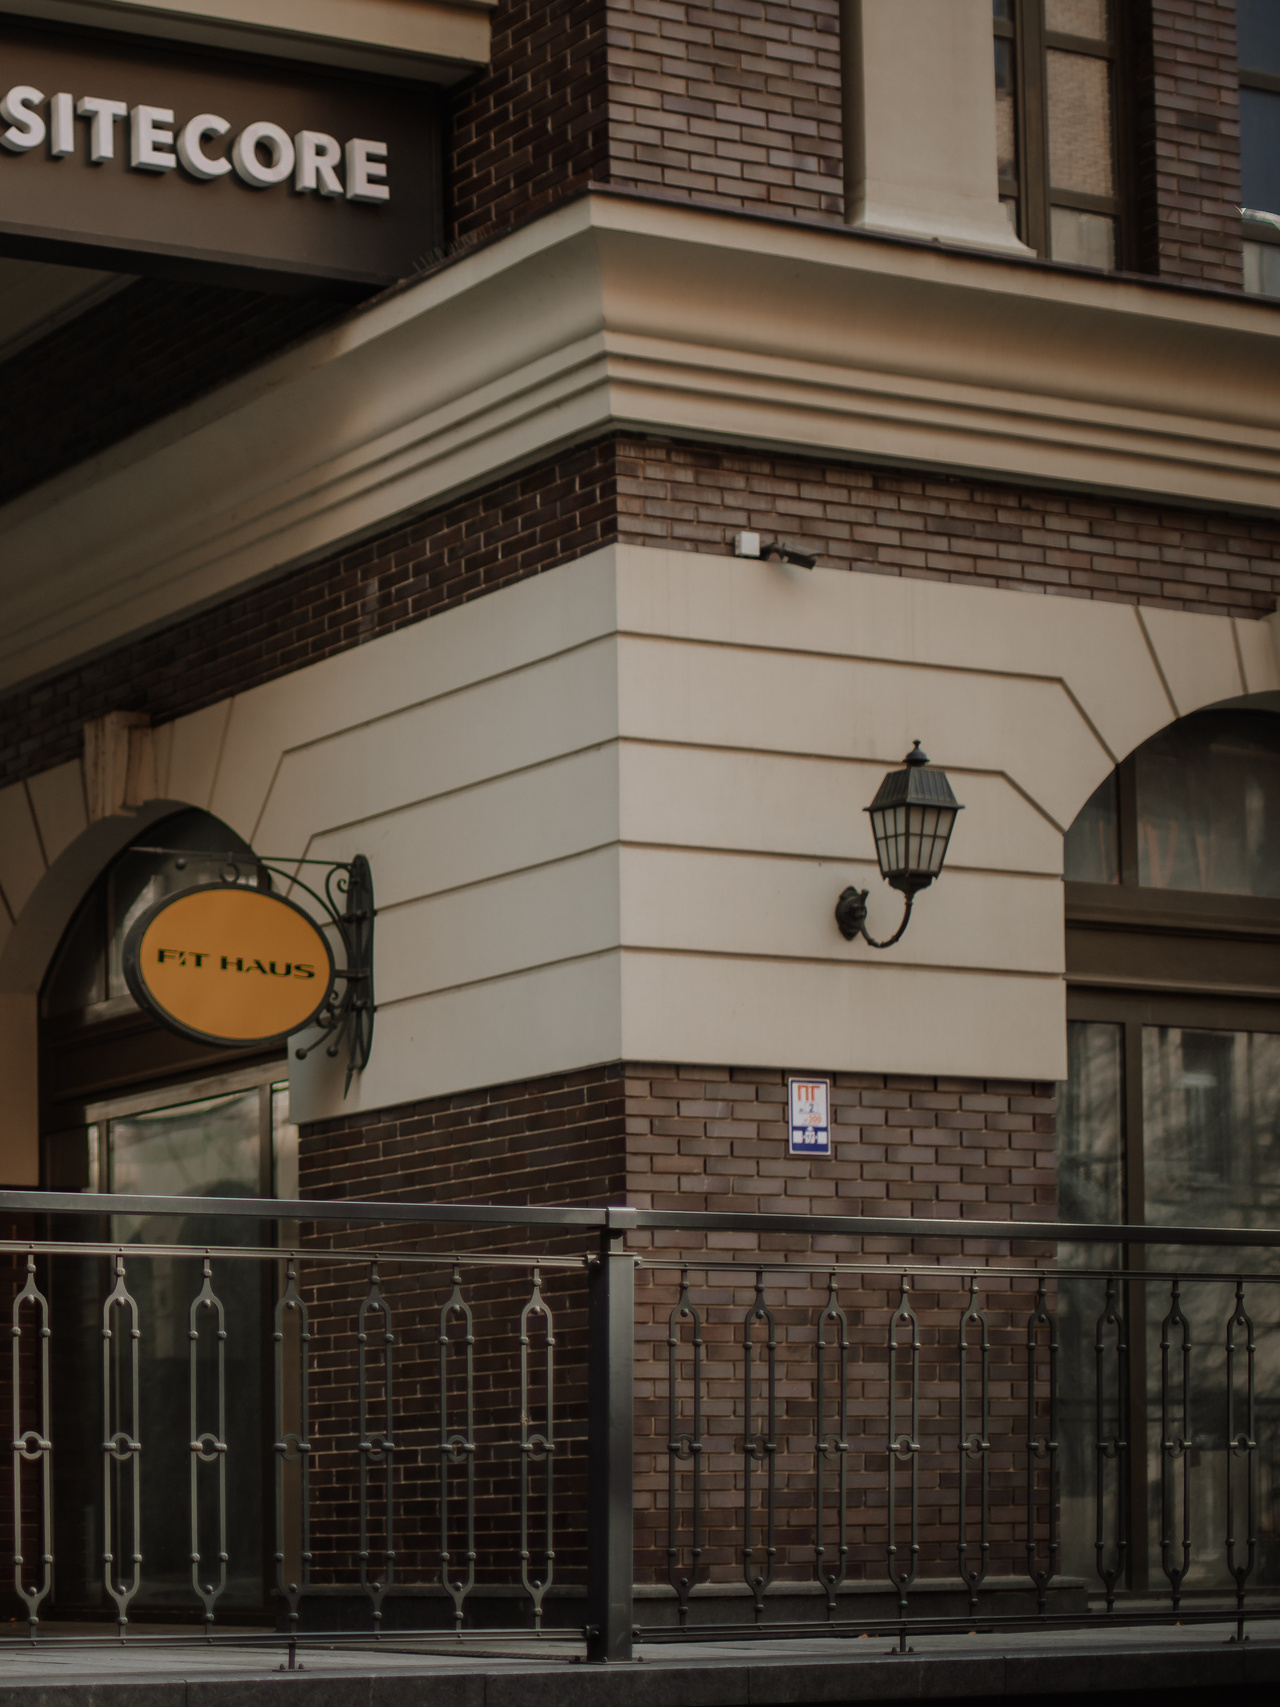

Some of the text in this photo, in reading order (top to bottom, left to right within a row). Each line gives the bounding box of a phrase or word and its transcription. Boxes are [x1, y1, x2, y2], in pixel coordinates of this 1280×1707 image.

[220, 956, 316, 979] HAUS
[797, 1084, 821, 1102] ПГ
[808, 1103, 815, 1113] 2
